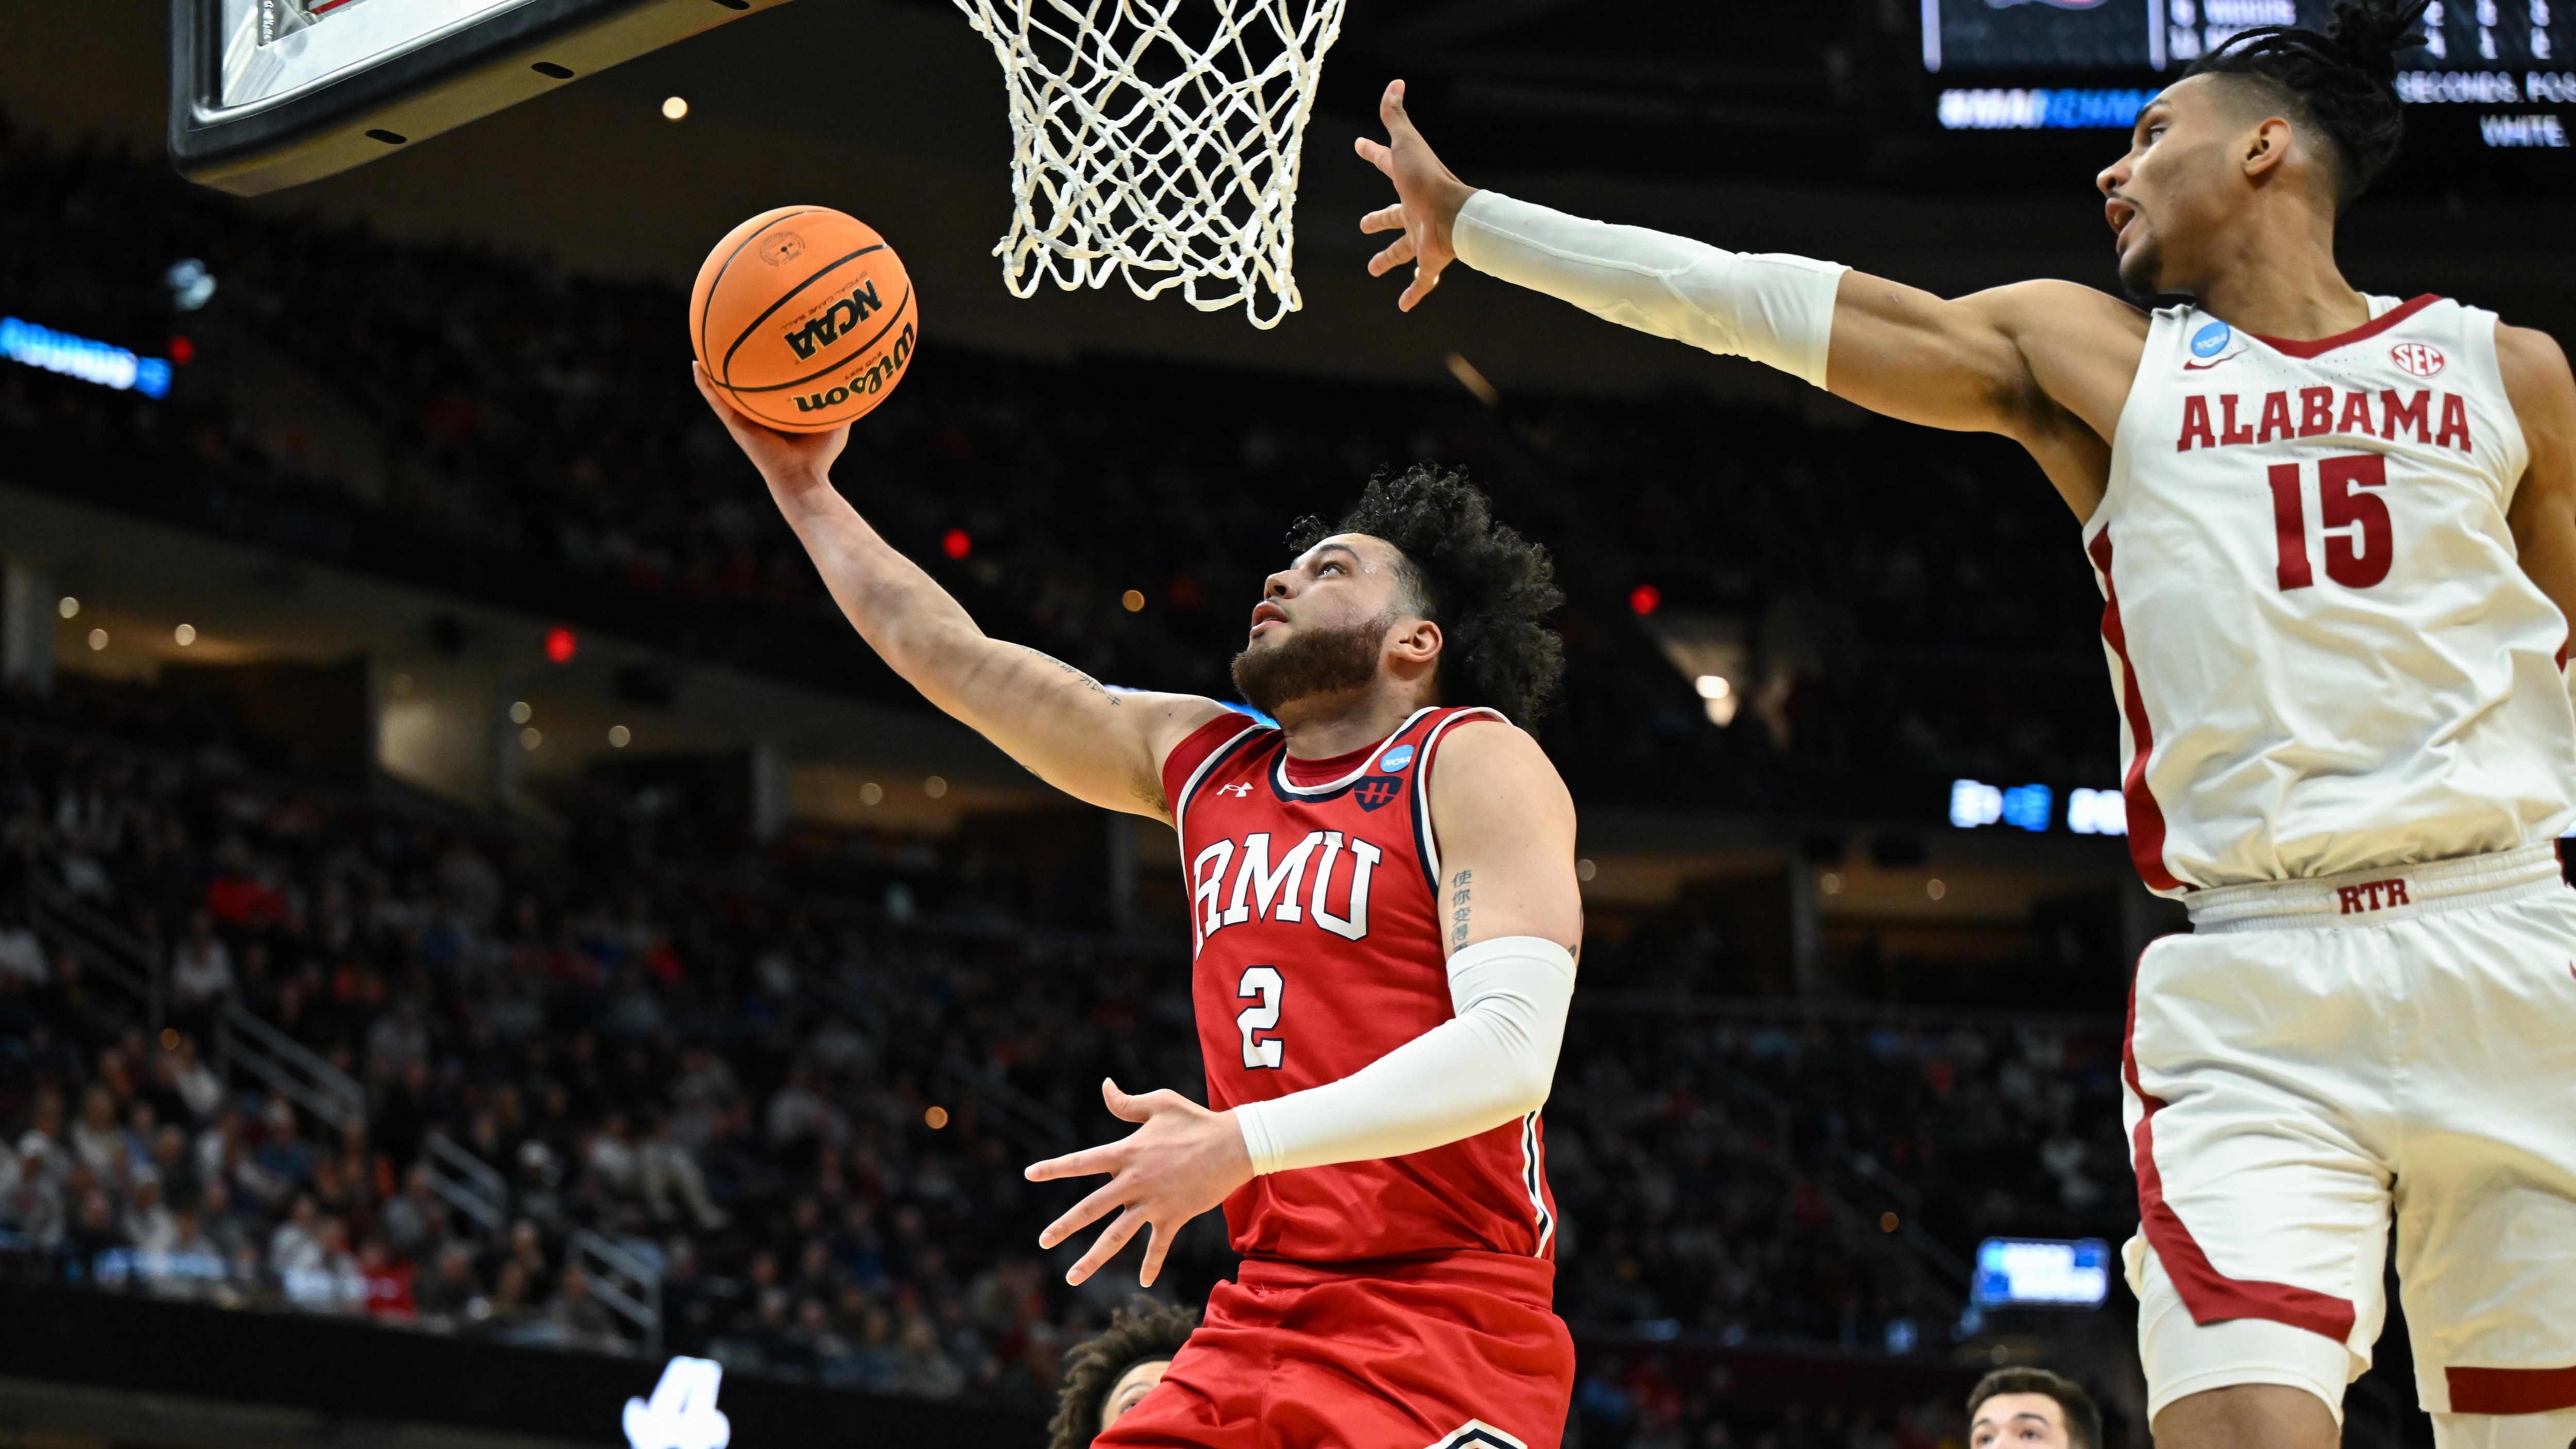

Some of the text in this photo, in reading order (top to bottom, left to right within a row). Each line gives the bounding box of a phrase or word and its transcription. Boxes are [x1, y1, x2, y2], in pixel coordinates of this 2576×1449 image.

[784, 277, 883, 363] NCAA
[2391, 344, 2443, 376] SEC
[791, 321, 915, 412] Wilson
[2177, 386, 2472, 453] ALABAMA
[2267, 454, 2394, 592] 15
[1383, 755, 1412, 766] NCAA
[1193, 829, 1383, 963] RMU
[2336, 878, 2410, 915] RTR
[1236, 965, 1285, 1071] 2
